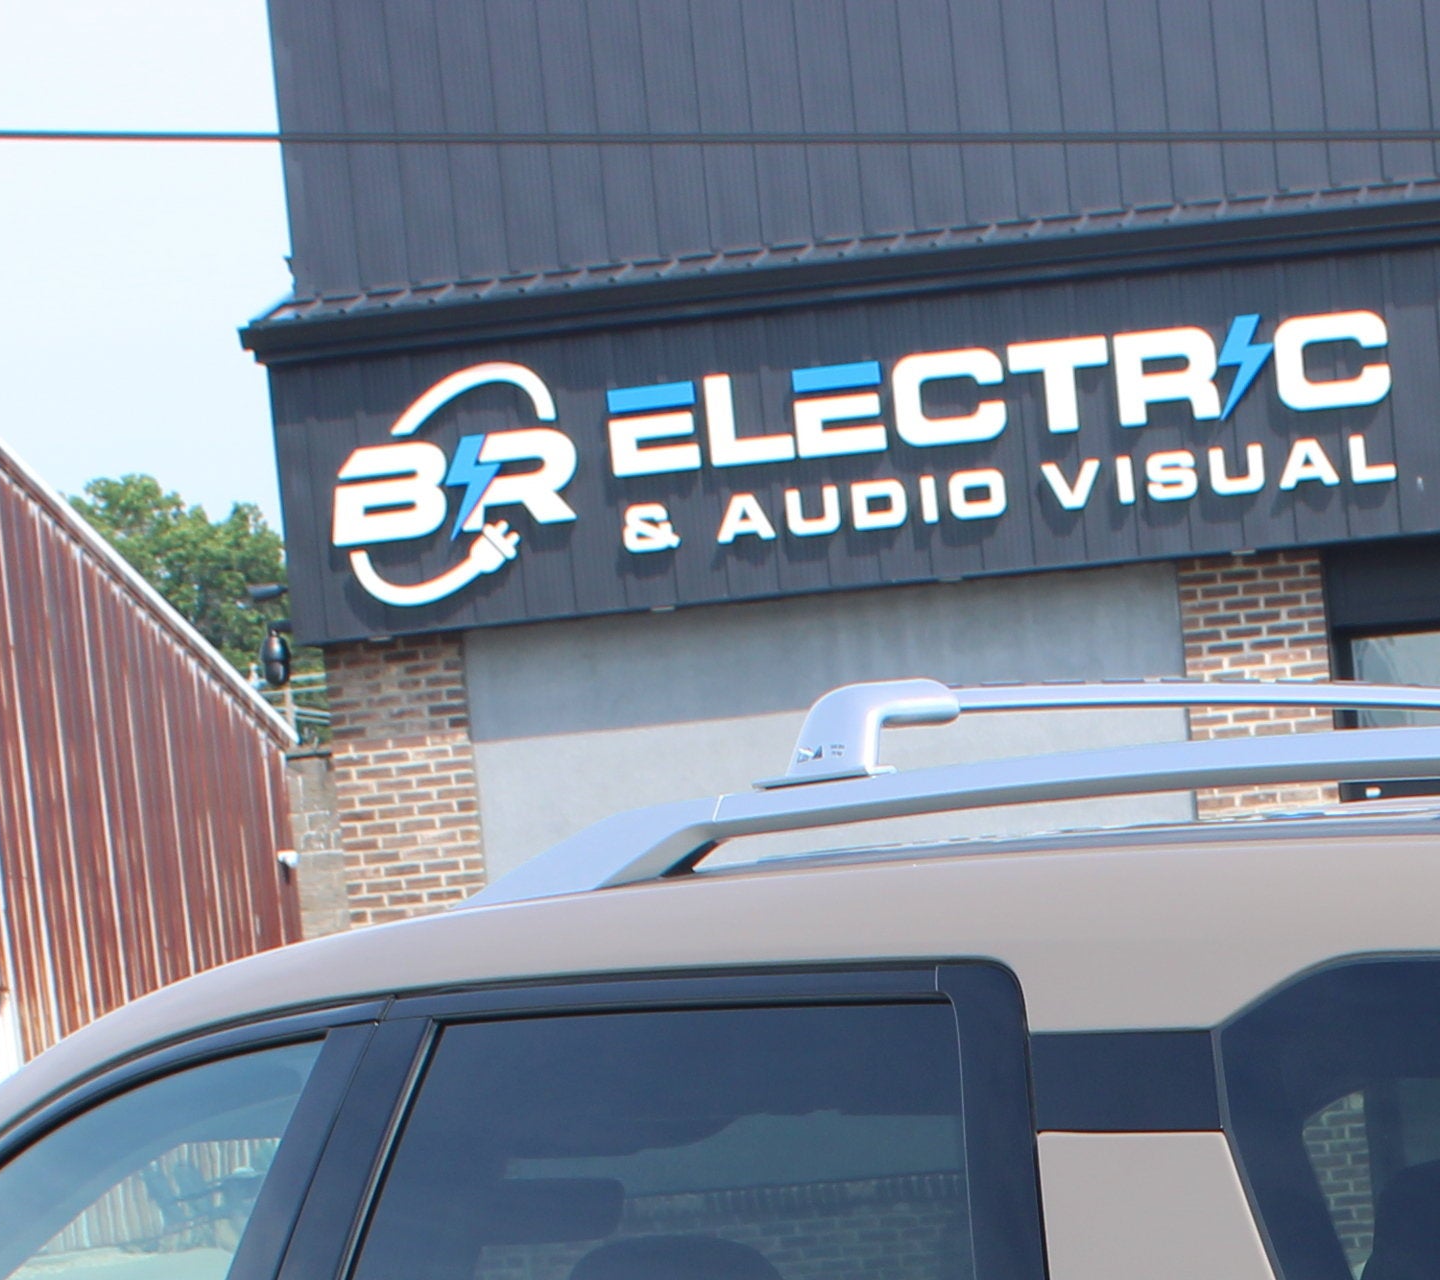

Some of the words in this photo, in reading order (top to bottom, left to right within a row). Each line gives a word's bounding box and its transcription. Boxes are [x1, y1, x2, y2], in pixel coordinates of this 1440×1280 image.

[607, 309, 1393, 478] ELECTRIC
[623, 502, 680, 555] &
[717, 467, 1008, 545] AUDIO
[1041, 434, 1398, 511] VISUAL
